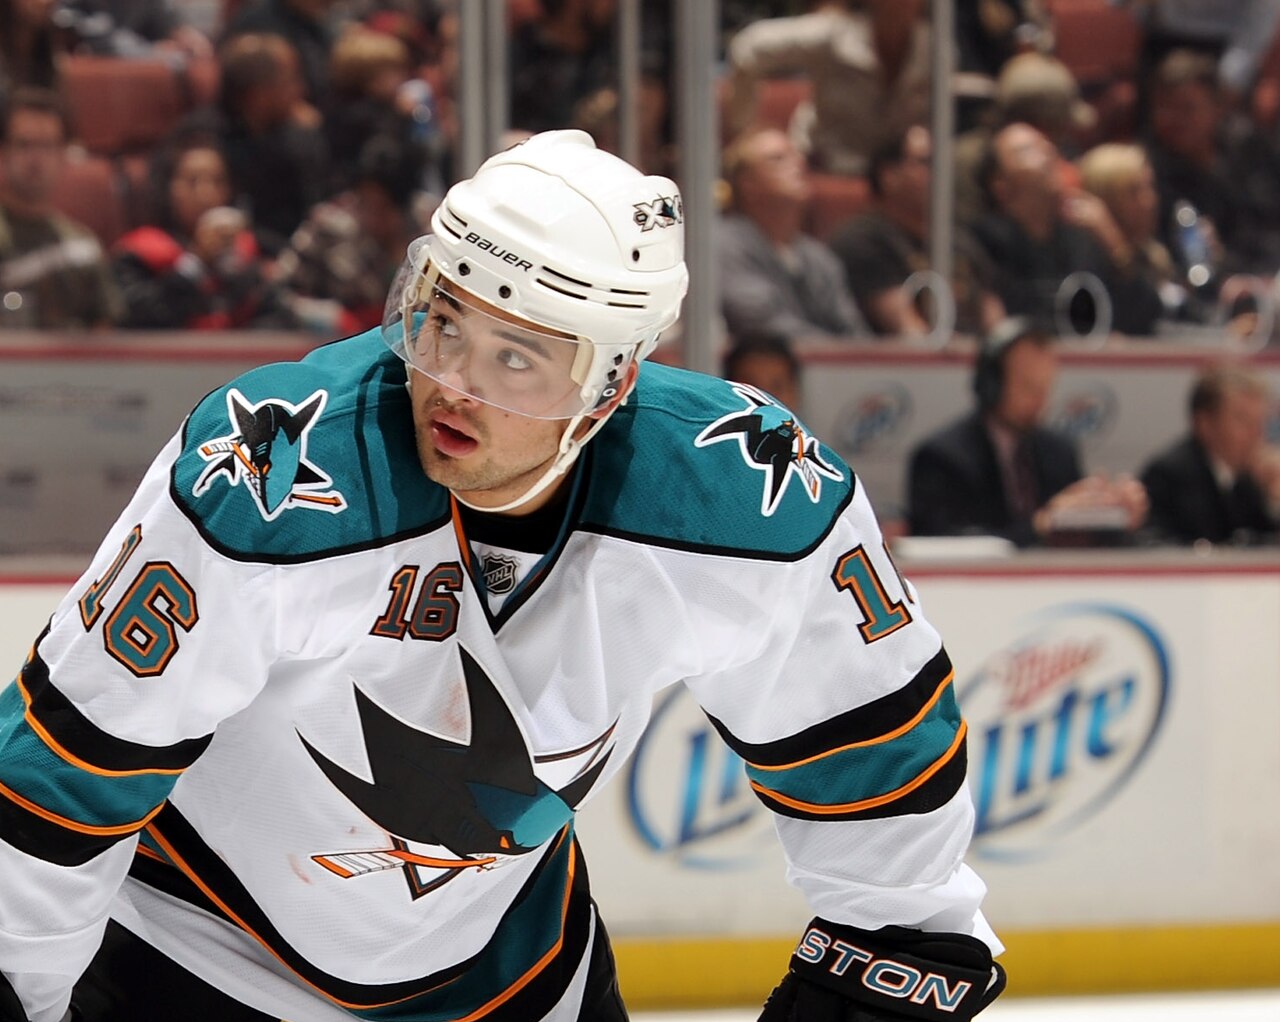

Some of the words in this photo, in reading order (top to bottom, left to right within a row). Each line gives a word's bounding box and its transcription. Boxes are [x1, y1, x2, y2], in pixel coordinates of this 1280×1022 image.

[77, 522, 200, 679] 16
[368, 560, 465, 643] 16
[485, 566, 512, 586] NHL
[830, 541, 915, 645] 1
[972, 675, 1138, 834] Lite
